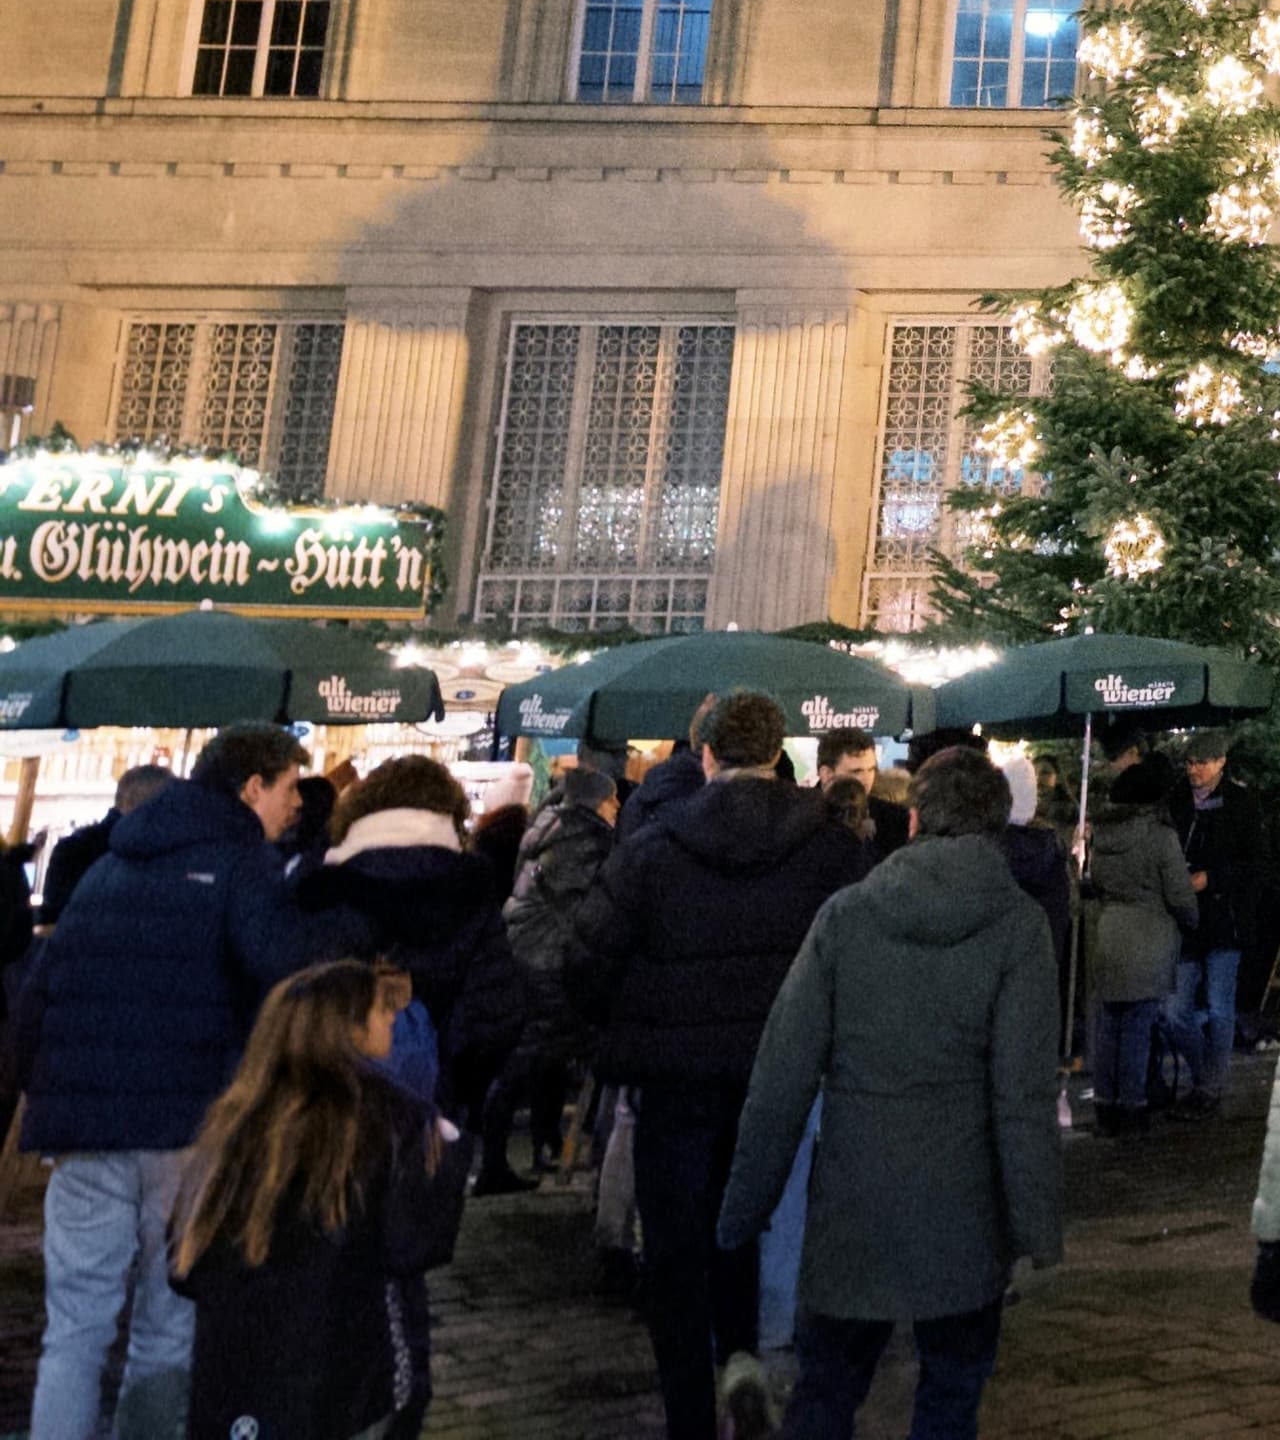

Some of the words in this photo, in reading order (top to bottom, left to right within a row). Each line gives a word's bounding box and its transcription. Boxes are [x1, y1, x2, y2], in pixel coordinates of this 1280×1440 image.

[326, 690, 402, 717] wiener
[1102, 684, 1176, 703] wiener
[521, 708, 571, 730] wiener
[808, 707, 880, 728] wiener
